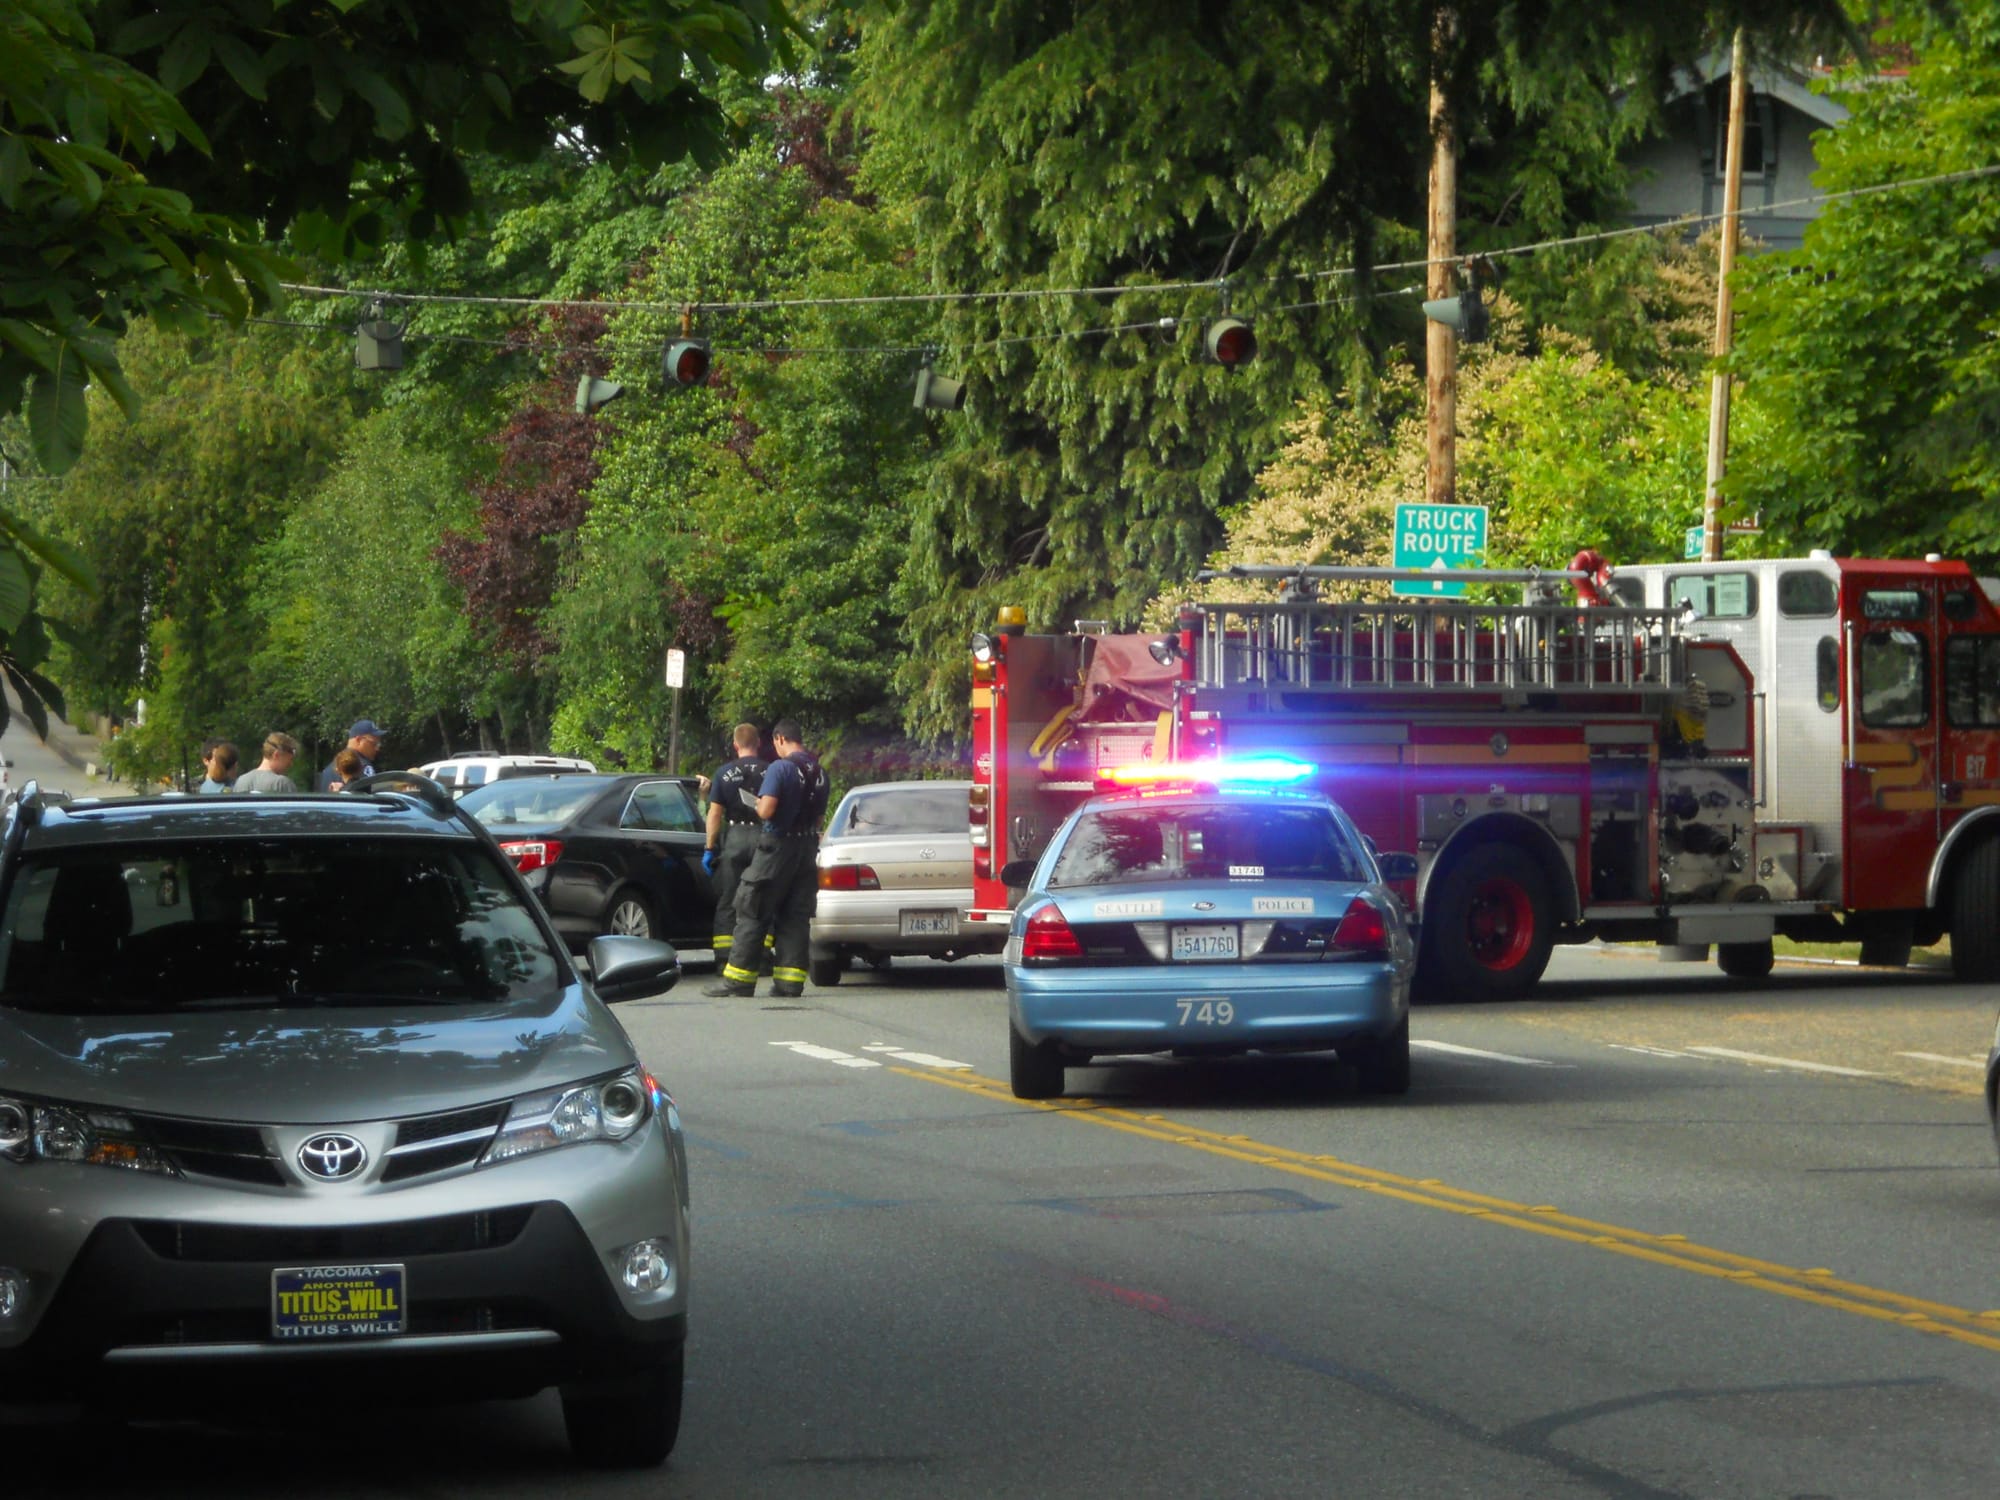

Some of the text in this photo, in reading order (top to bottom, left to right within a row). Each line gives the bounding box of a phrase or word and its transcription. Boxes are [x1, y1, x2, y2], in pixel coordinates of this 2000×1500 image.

[1404, 509, 1477, 532] TRUCK
[1404, 532, 1476, 554] ROUTE
[1097, 902, 1157, 915] SEATTLE
[1257, 900, 1308, 910] POLICE
[1184, 937, 1234, 953] 54176D
[1176, 1002, 1234, 1025] 749
[305, 1266, 373, 1278] TACOMA
[303, 1280, 376, 1290] ANOTHER
[278, 1288, 399, 1314] TITUS-WILL
[299, 1312, 380, 1322] CUSTOMER
